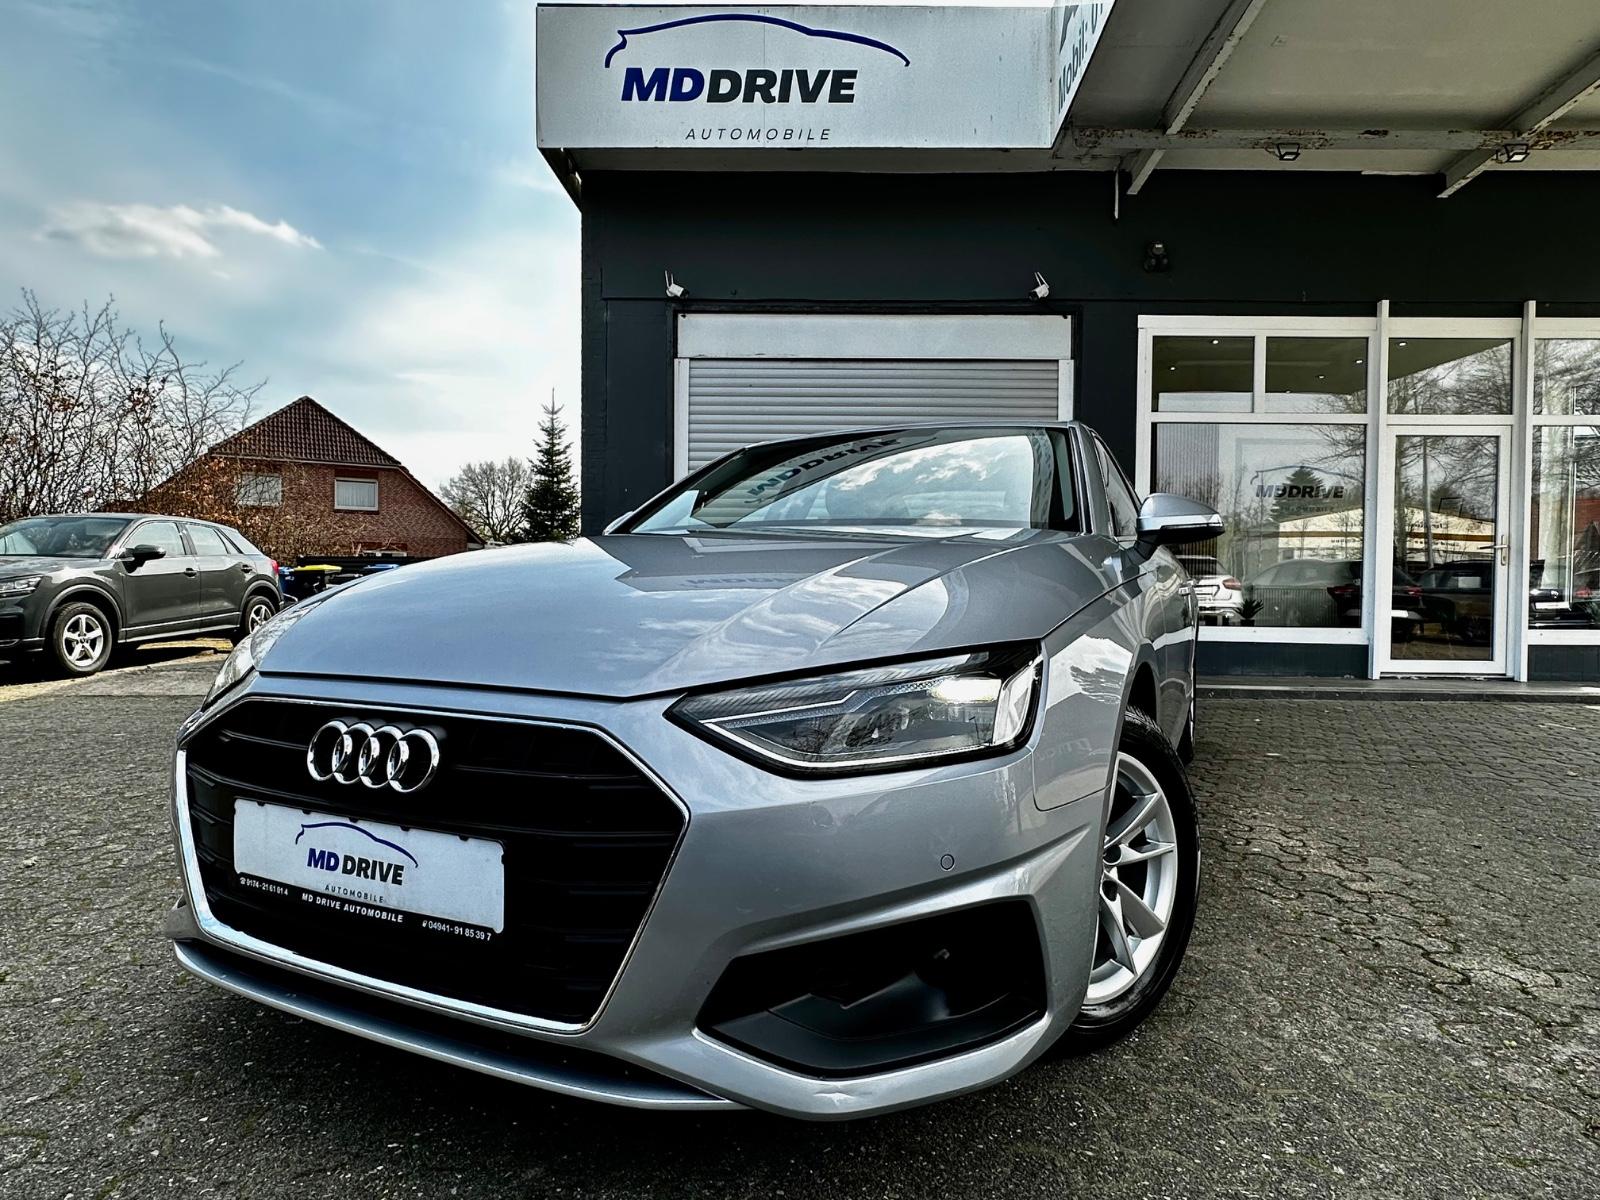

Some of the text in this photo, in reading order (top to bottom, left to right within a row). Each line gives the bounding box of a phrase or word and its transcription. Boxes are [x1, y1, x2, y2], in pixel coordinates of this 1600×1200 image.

[1058, 18, 1088, 115] Mobil:
[685, 127, 832, 141] AUTOMOBILE
[325, 884, 384, 903] AUTOMOBILE
[302, 892, 404, 923] MD DRIVE AUTOMOBILE
